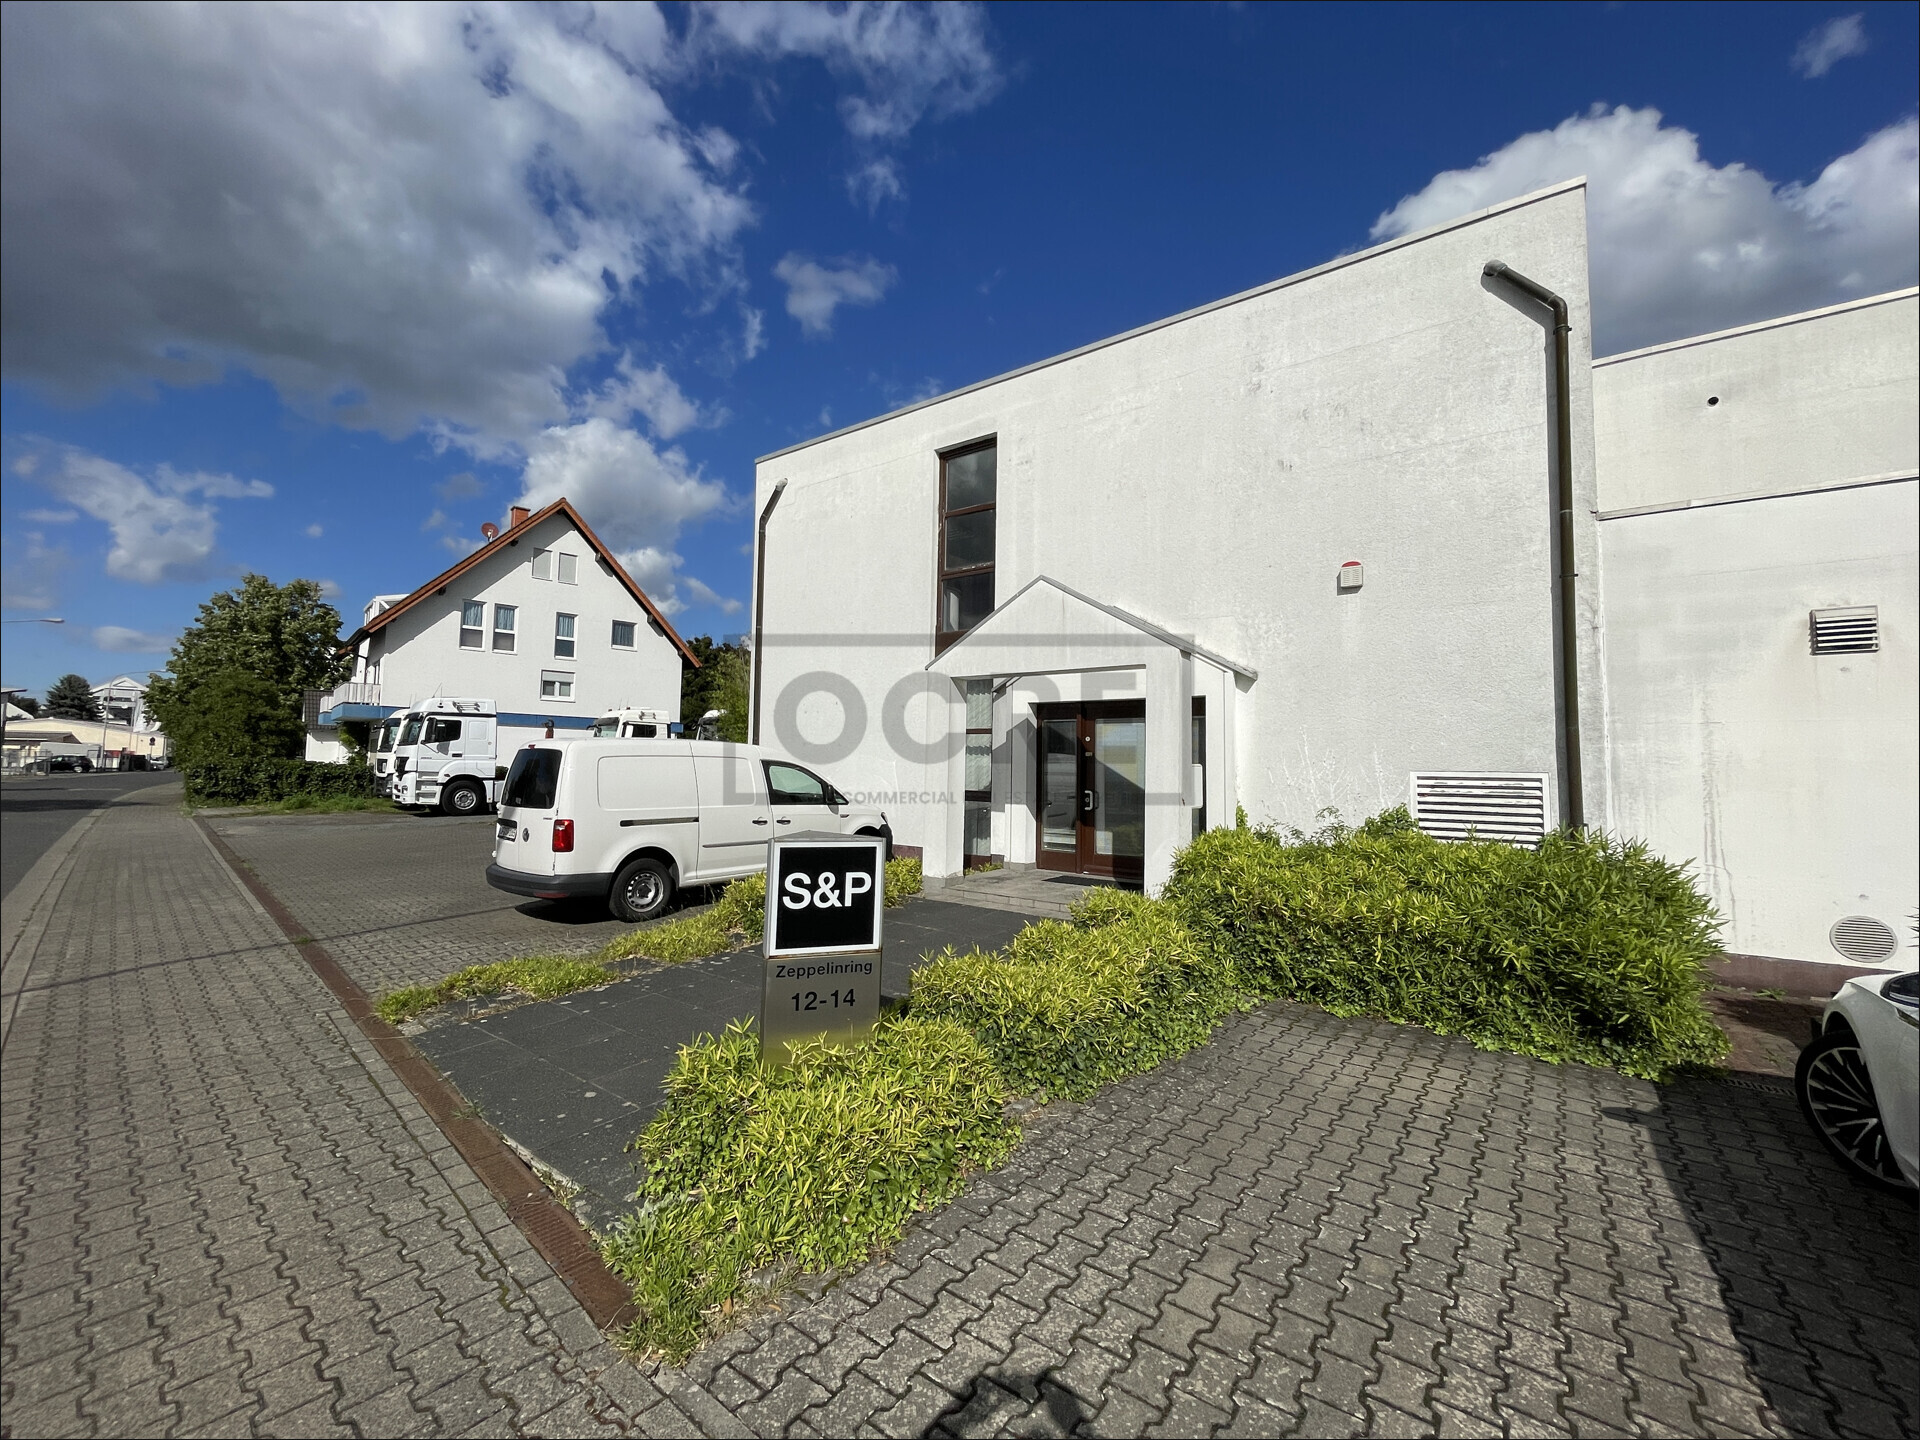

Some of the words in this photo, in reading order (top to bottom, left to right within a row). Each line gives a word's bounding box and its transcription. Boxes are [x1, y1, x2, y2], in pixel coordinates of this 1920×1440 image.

[782, 871, 872, 910] S&P
[775, 960, 873, 979] Zeppelinring
[791, 988, 856, 1012] 12-14
